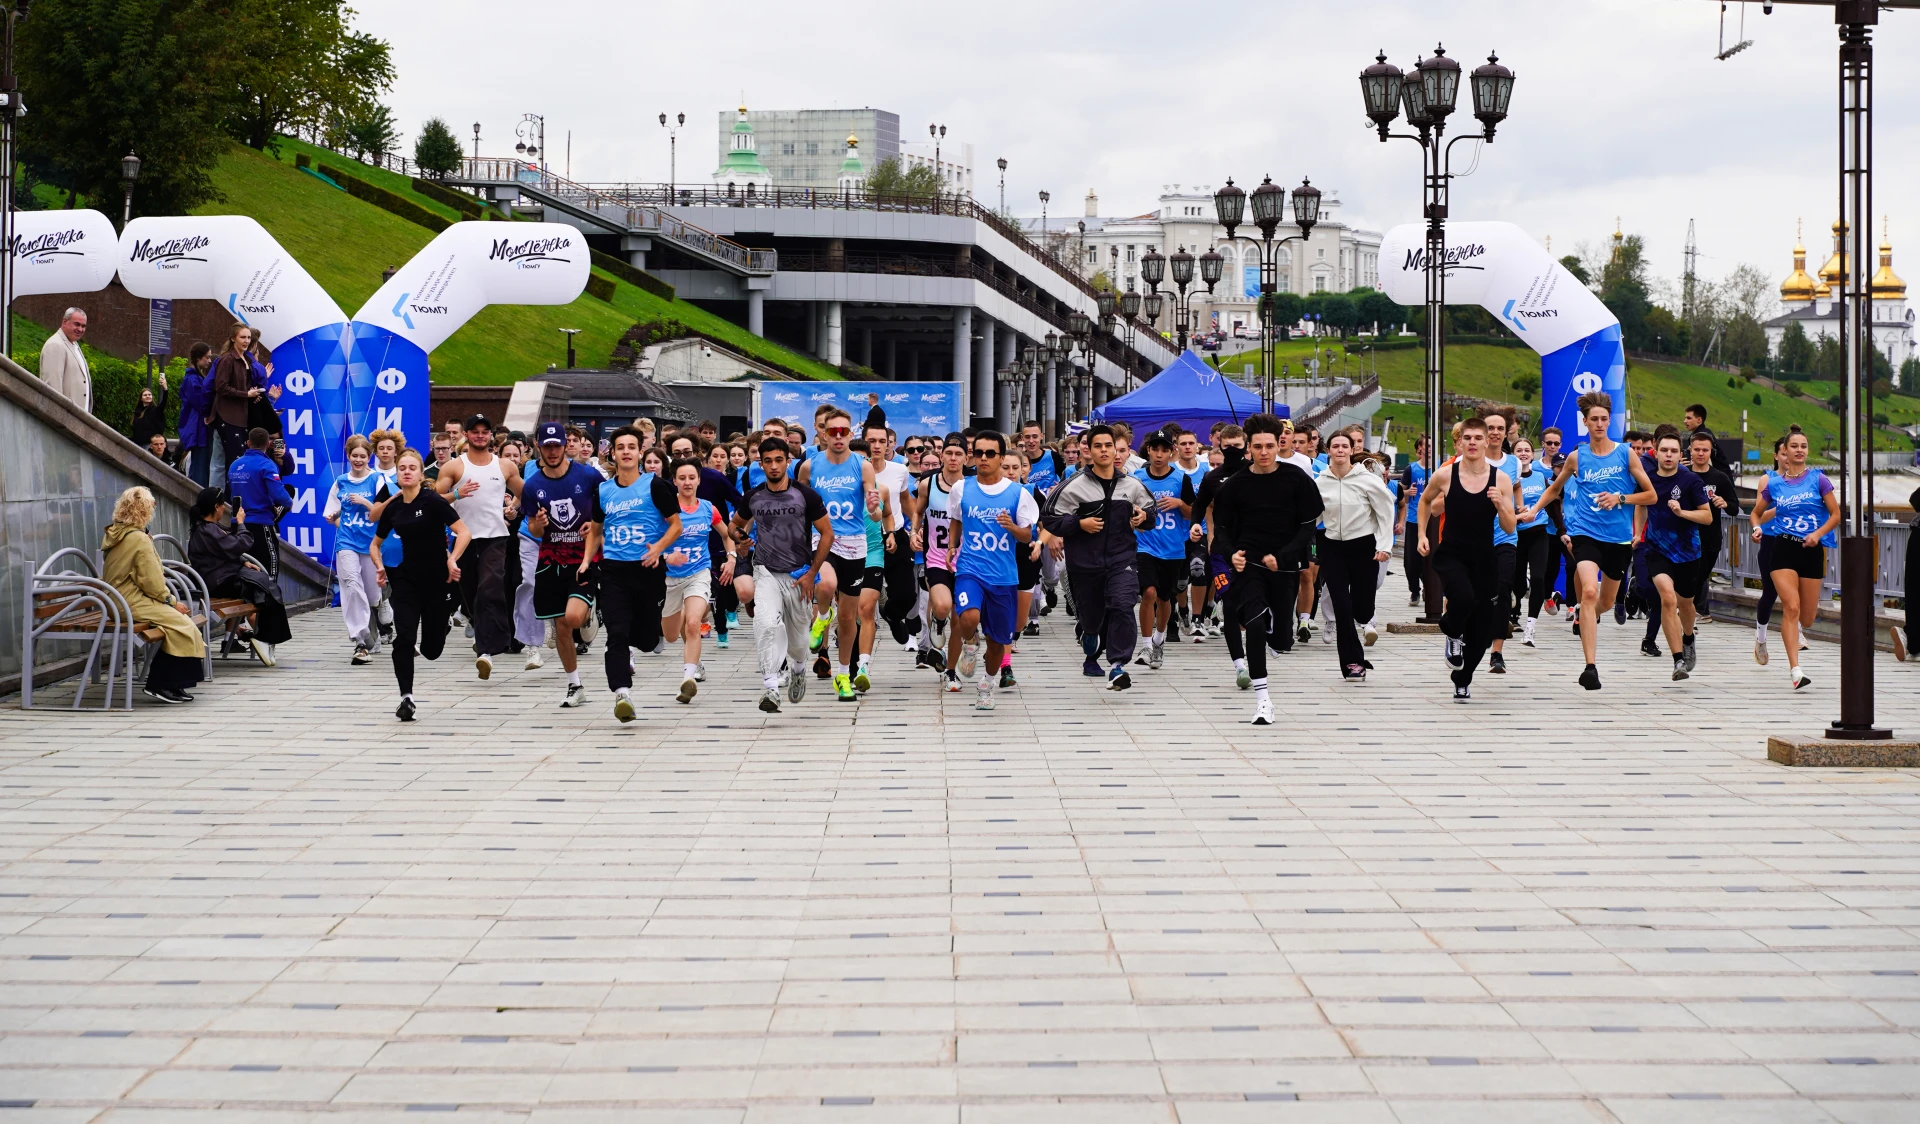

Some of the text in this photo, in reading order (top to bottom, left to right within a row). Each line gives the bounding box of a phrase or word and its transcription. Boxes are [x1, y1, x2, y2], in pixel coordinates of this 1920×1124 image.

[343, 511, 375, 527] 345
[756, 507, 797, 517] MANTO
[823, 500, 855, 520] 02
[1782, 513, 1818, 532] 261
[609, 525, 646, 545] 105
[968, 531, 1010, 552] 306
[958, 591, 969, 607] 9
